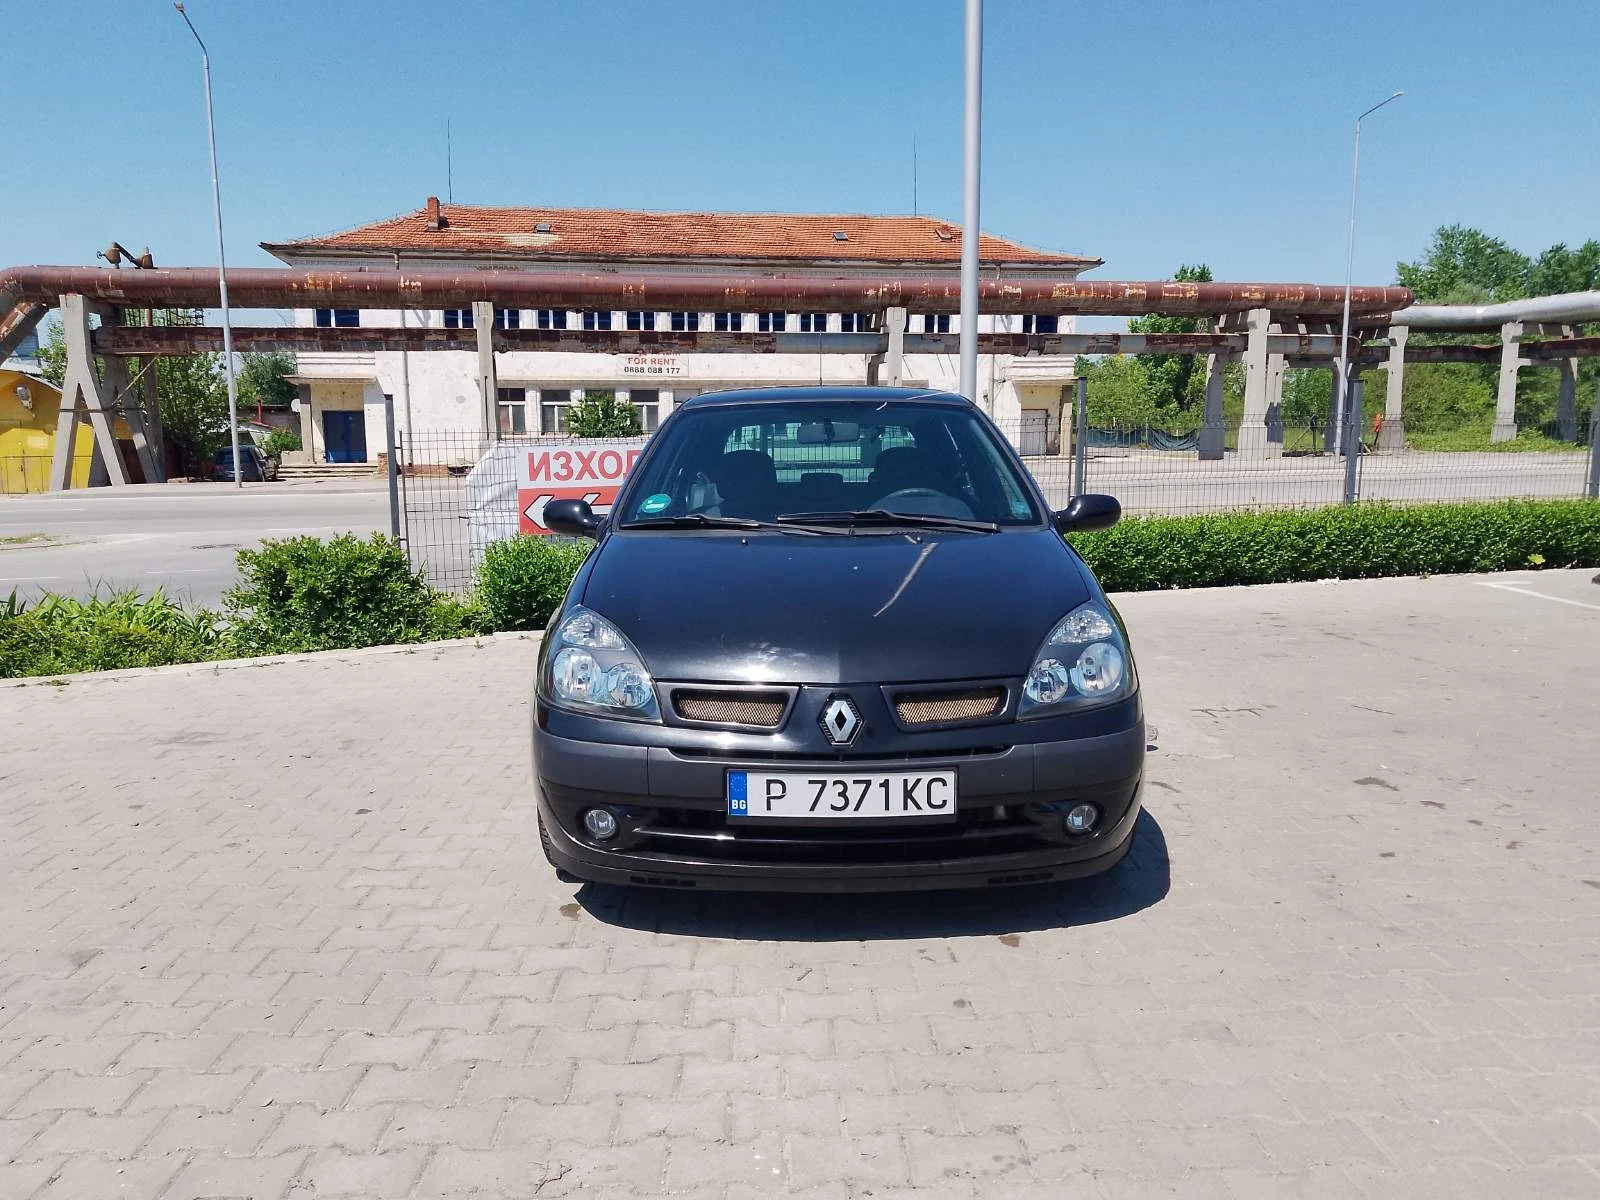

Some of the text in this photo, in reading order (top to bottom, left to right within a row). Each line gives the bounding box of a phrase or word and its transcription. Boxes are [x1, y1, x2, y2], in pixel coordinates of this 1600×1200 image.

[628, 357, 677, 366] FOR RENT
[731, 799, 747, 810] BG
